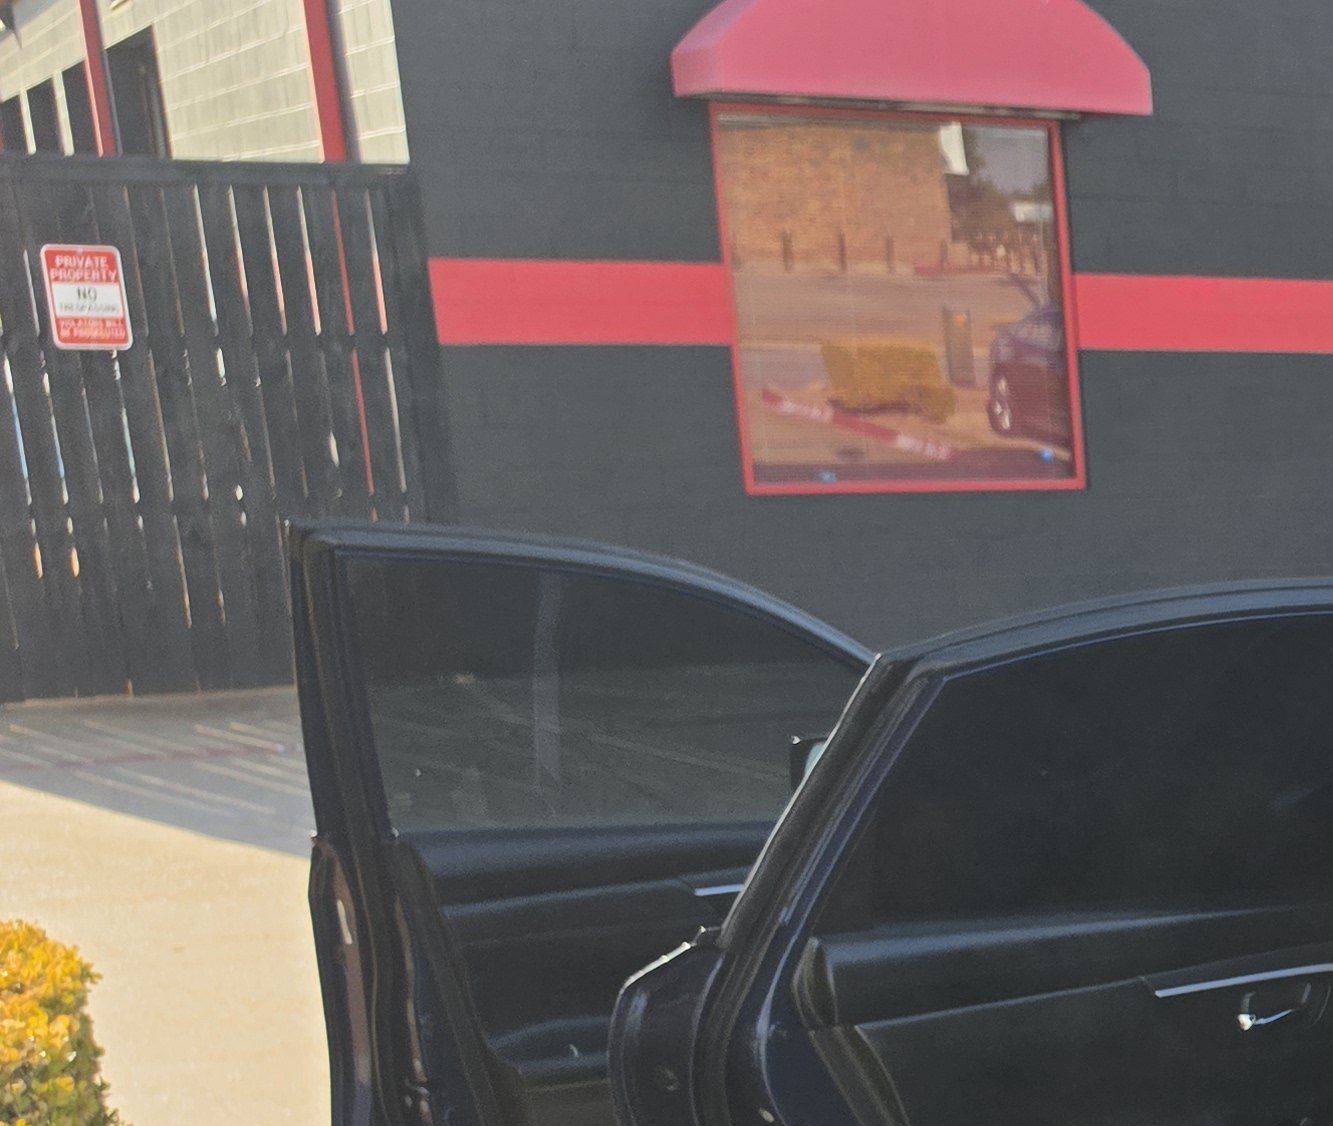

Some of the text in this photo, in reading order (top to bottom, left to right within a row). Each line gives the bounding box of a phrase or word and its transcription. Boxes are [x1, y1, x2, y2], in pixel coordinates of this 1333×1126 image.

[55, 255, 109, 269] PRIVATE
[50, 268, 117, 283] PROPERTY
[77, 287, 98, 302] NO
